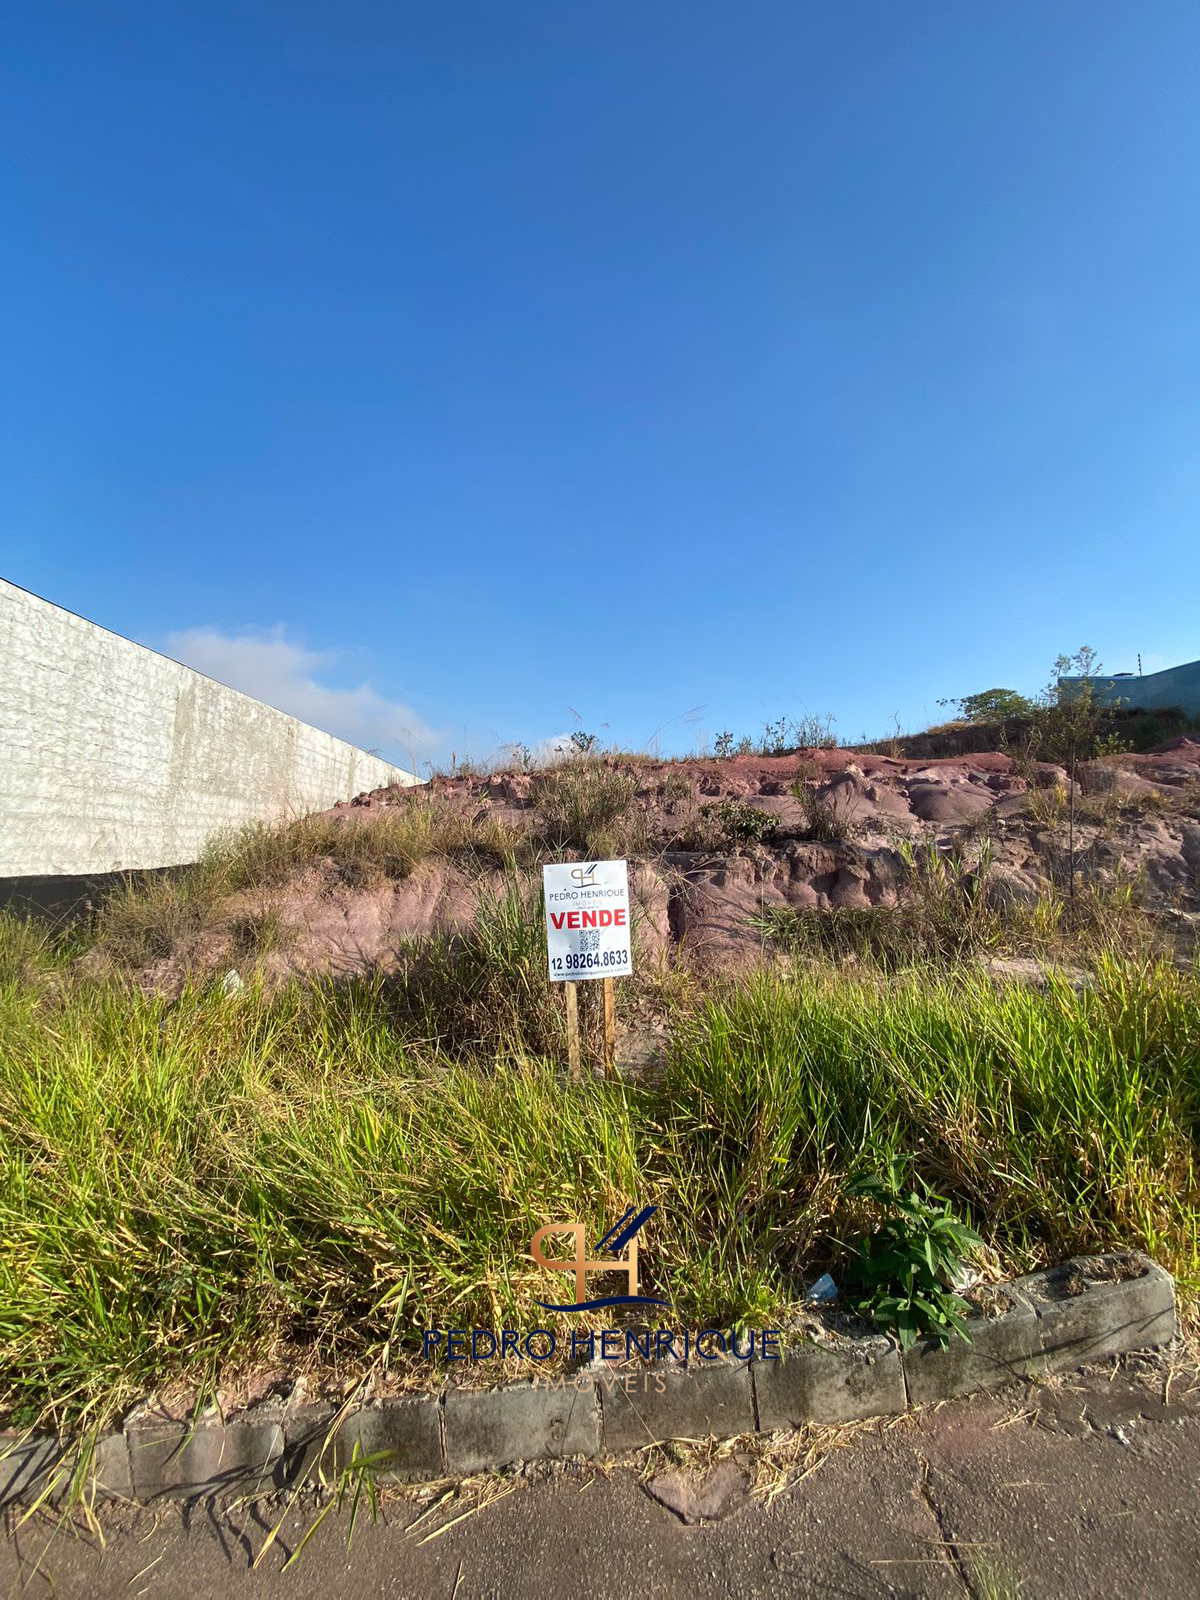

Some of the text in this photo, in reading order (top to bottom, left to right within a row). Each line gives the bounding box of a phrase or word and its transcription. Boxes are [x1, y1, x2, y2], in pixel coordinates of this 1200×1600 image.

[549, 888, 625, 901] PEDRO HENRIQUE
[550, 908, 627, 930] VENDE
[551, 949, 628, 970] 12 98264.8633
